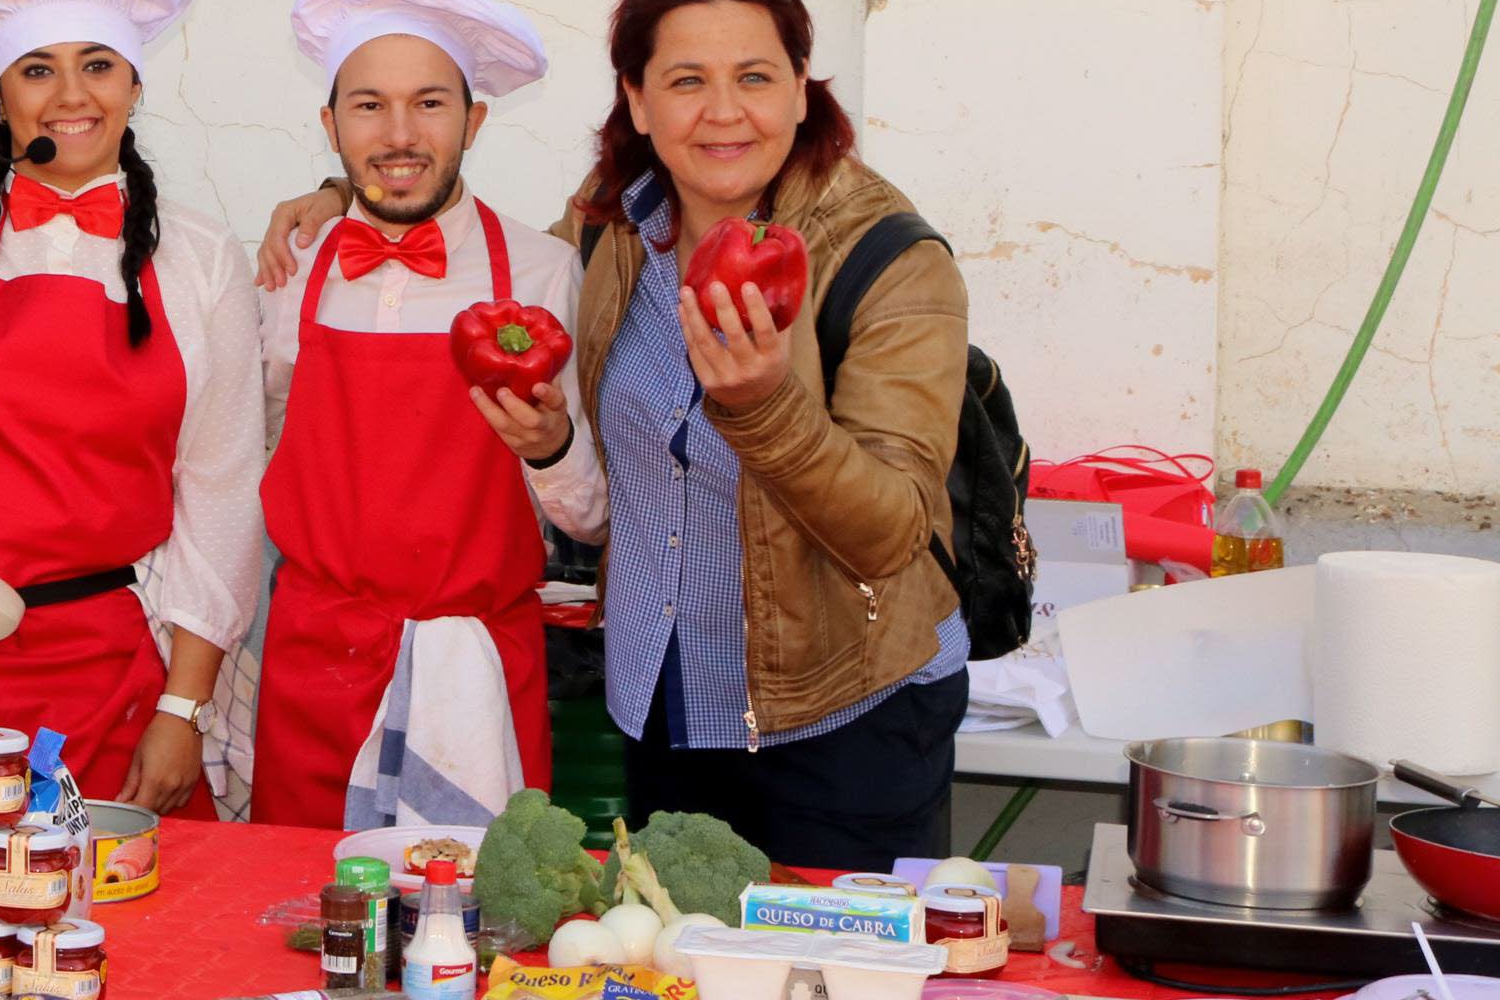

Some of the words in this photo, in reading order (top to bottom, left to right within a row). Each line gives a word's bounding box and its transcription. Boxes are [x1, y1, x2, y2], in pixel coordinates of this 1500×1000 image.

[756, 907, 814, 927] QUESO
[819, 917, 834, 928] DE
[838, 916, 897, 937] CABRA
[439, 966, 467, 976] Gourmet
[510, 972, 571, 987] Queso
